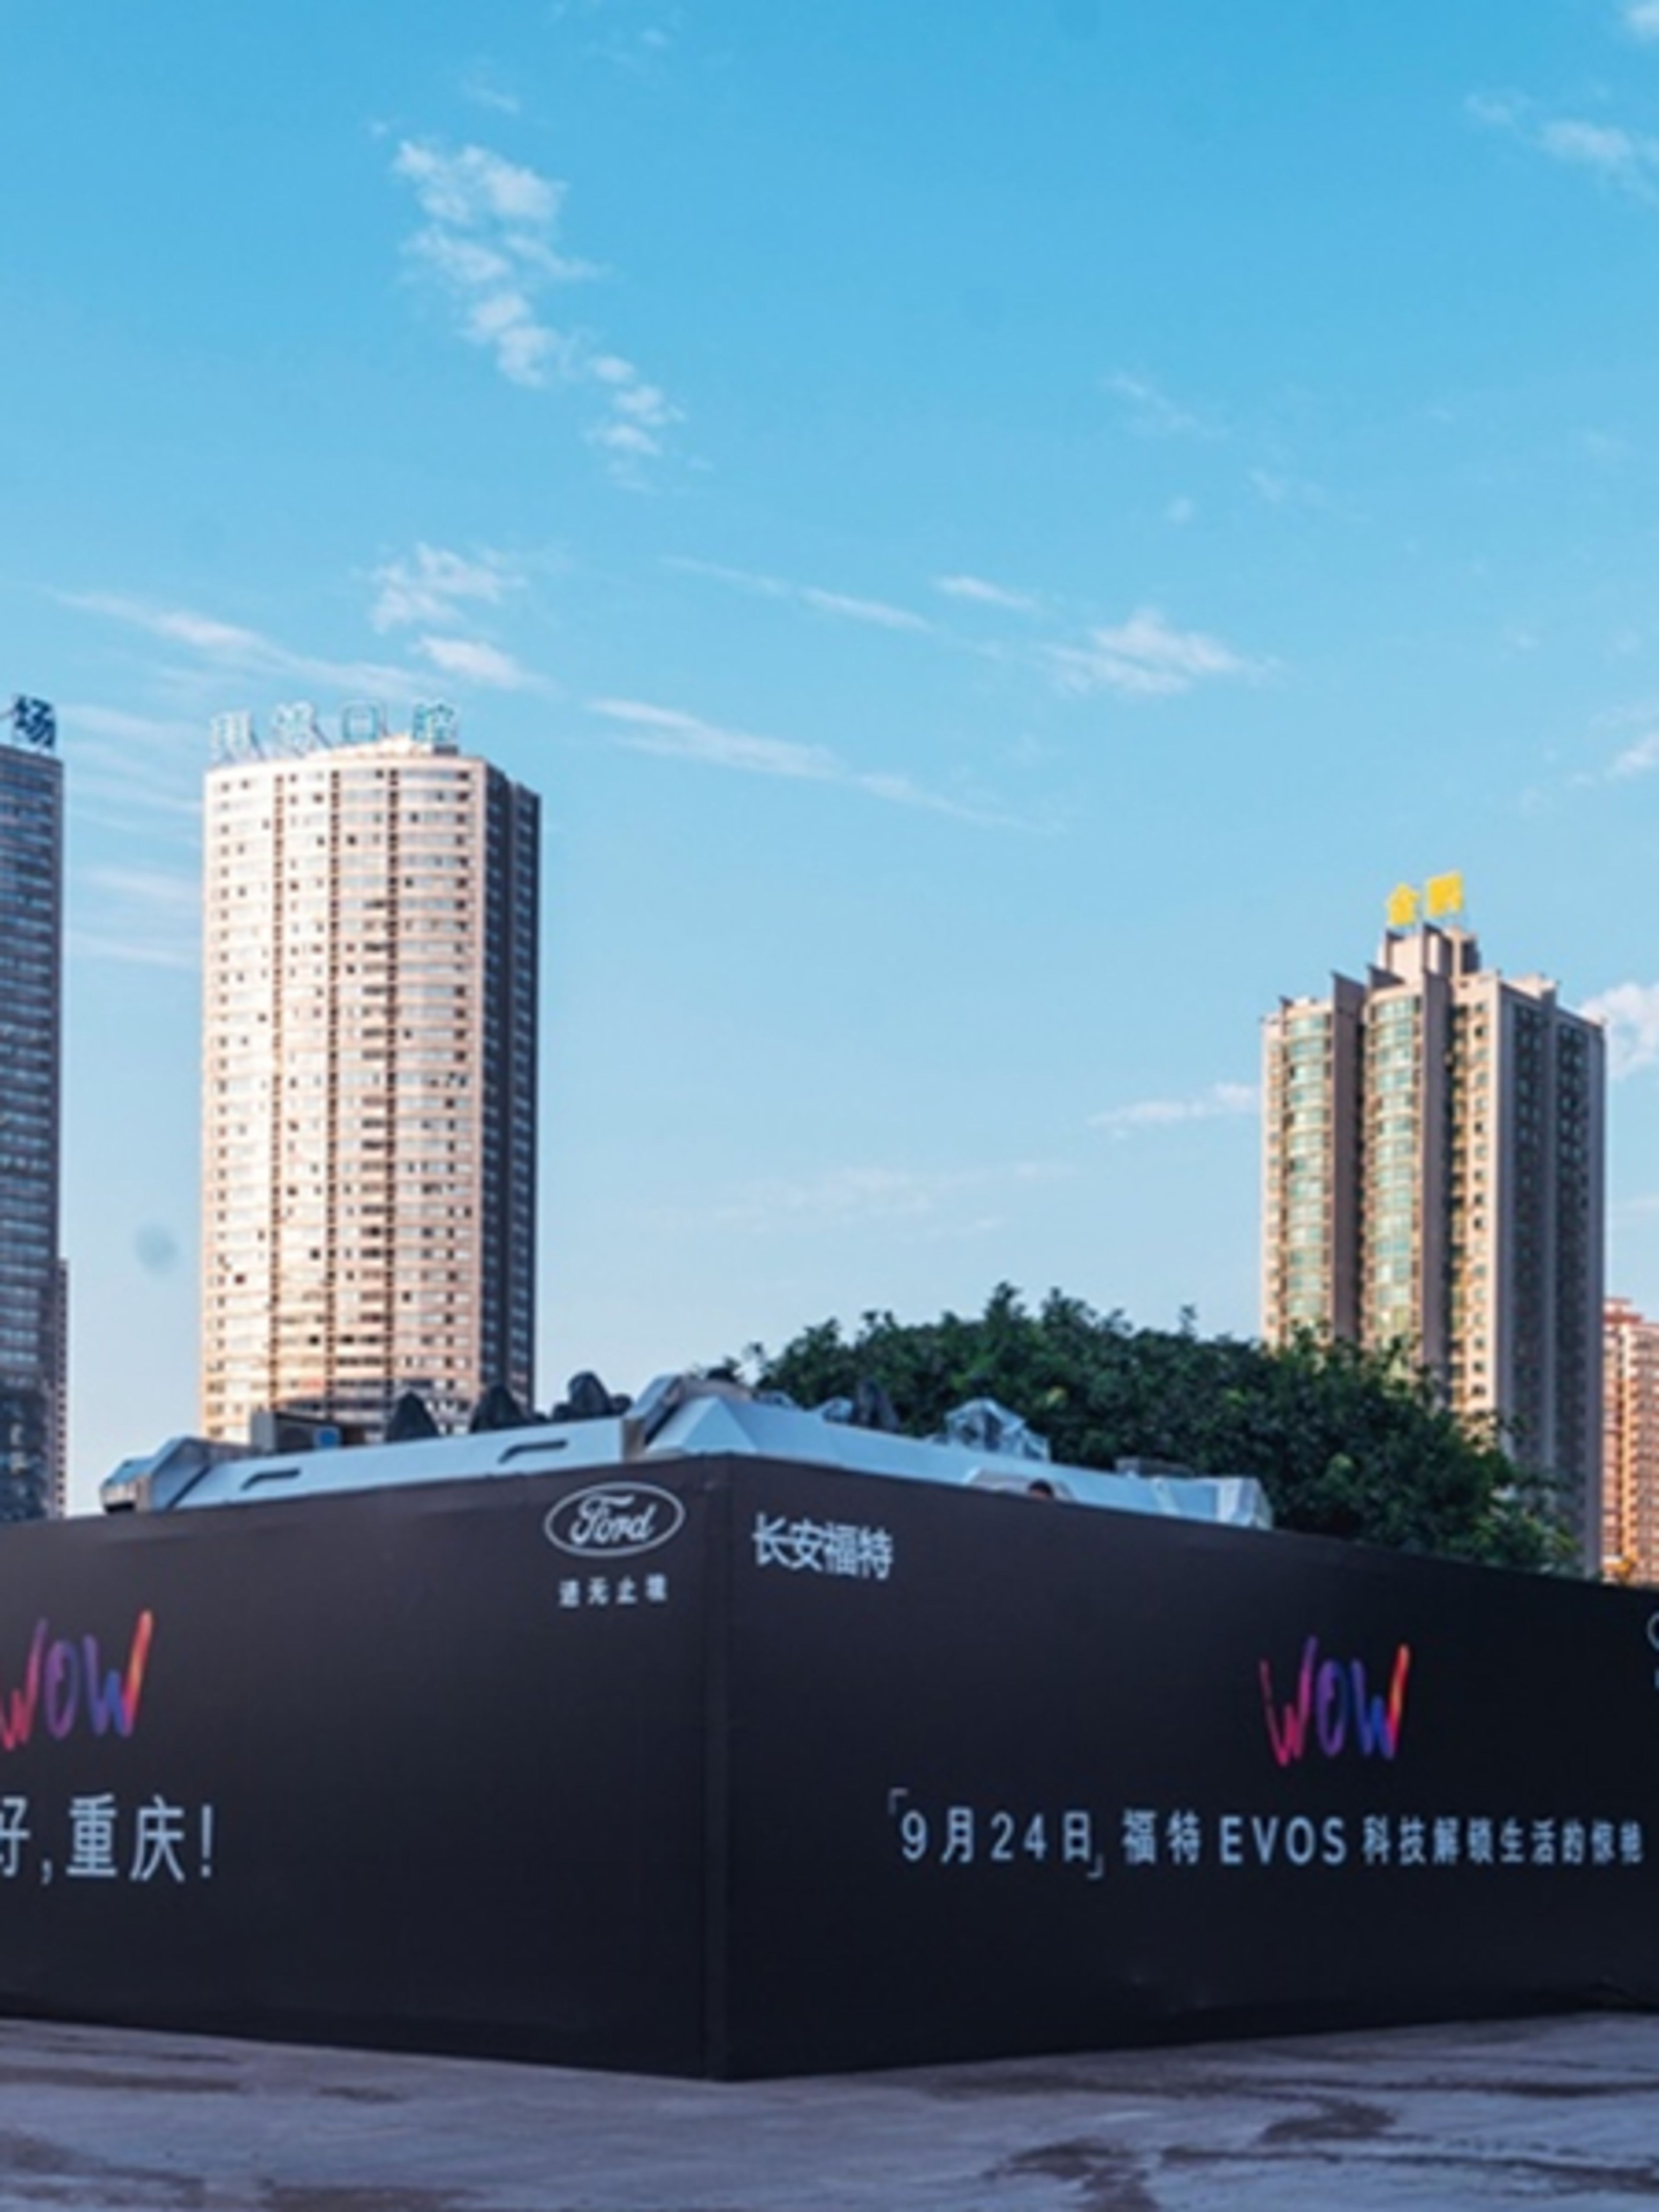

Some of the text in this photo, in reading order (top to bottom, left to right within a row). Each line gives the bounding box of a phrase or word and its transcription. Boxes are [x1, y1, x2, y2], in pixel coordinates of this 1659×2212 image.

[569, 1490, 658, 1548] Ford
[753, 1512, 893, 1580] 长安福特
[1259, 1636, 1411, 1767] WOW
[1122, 1808, 1200, 1866] 福特
[1220, 1815, 1347, 1866] EVOS
